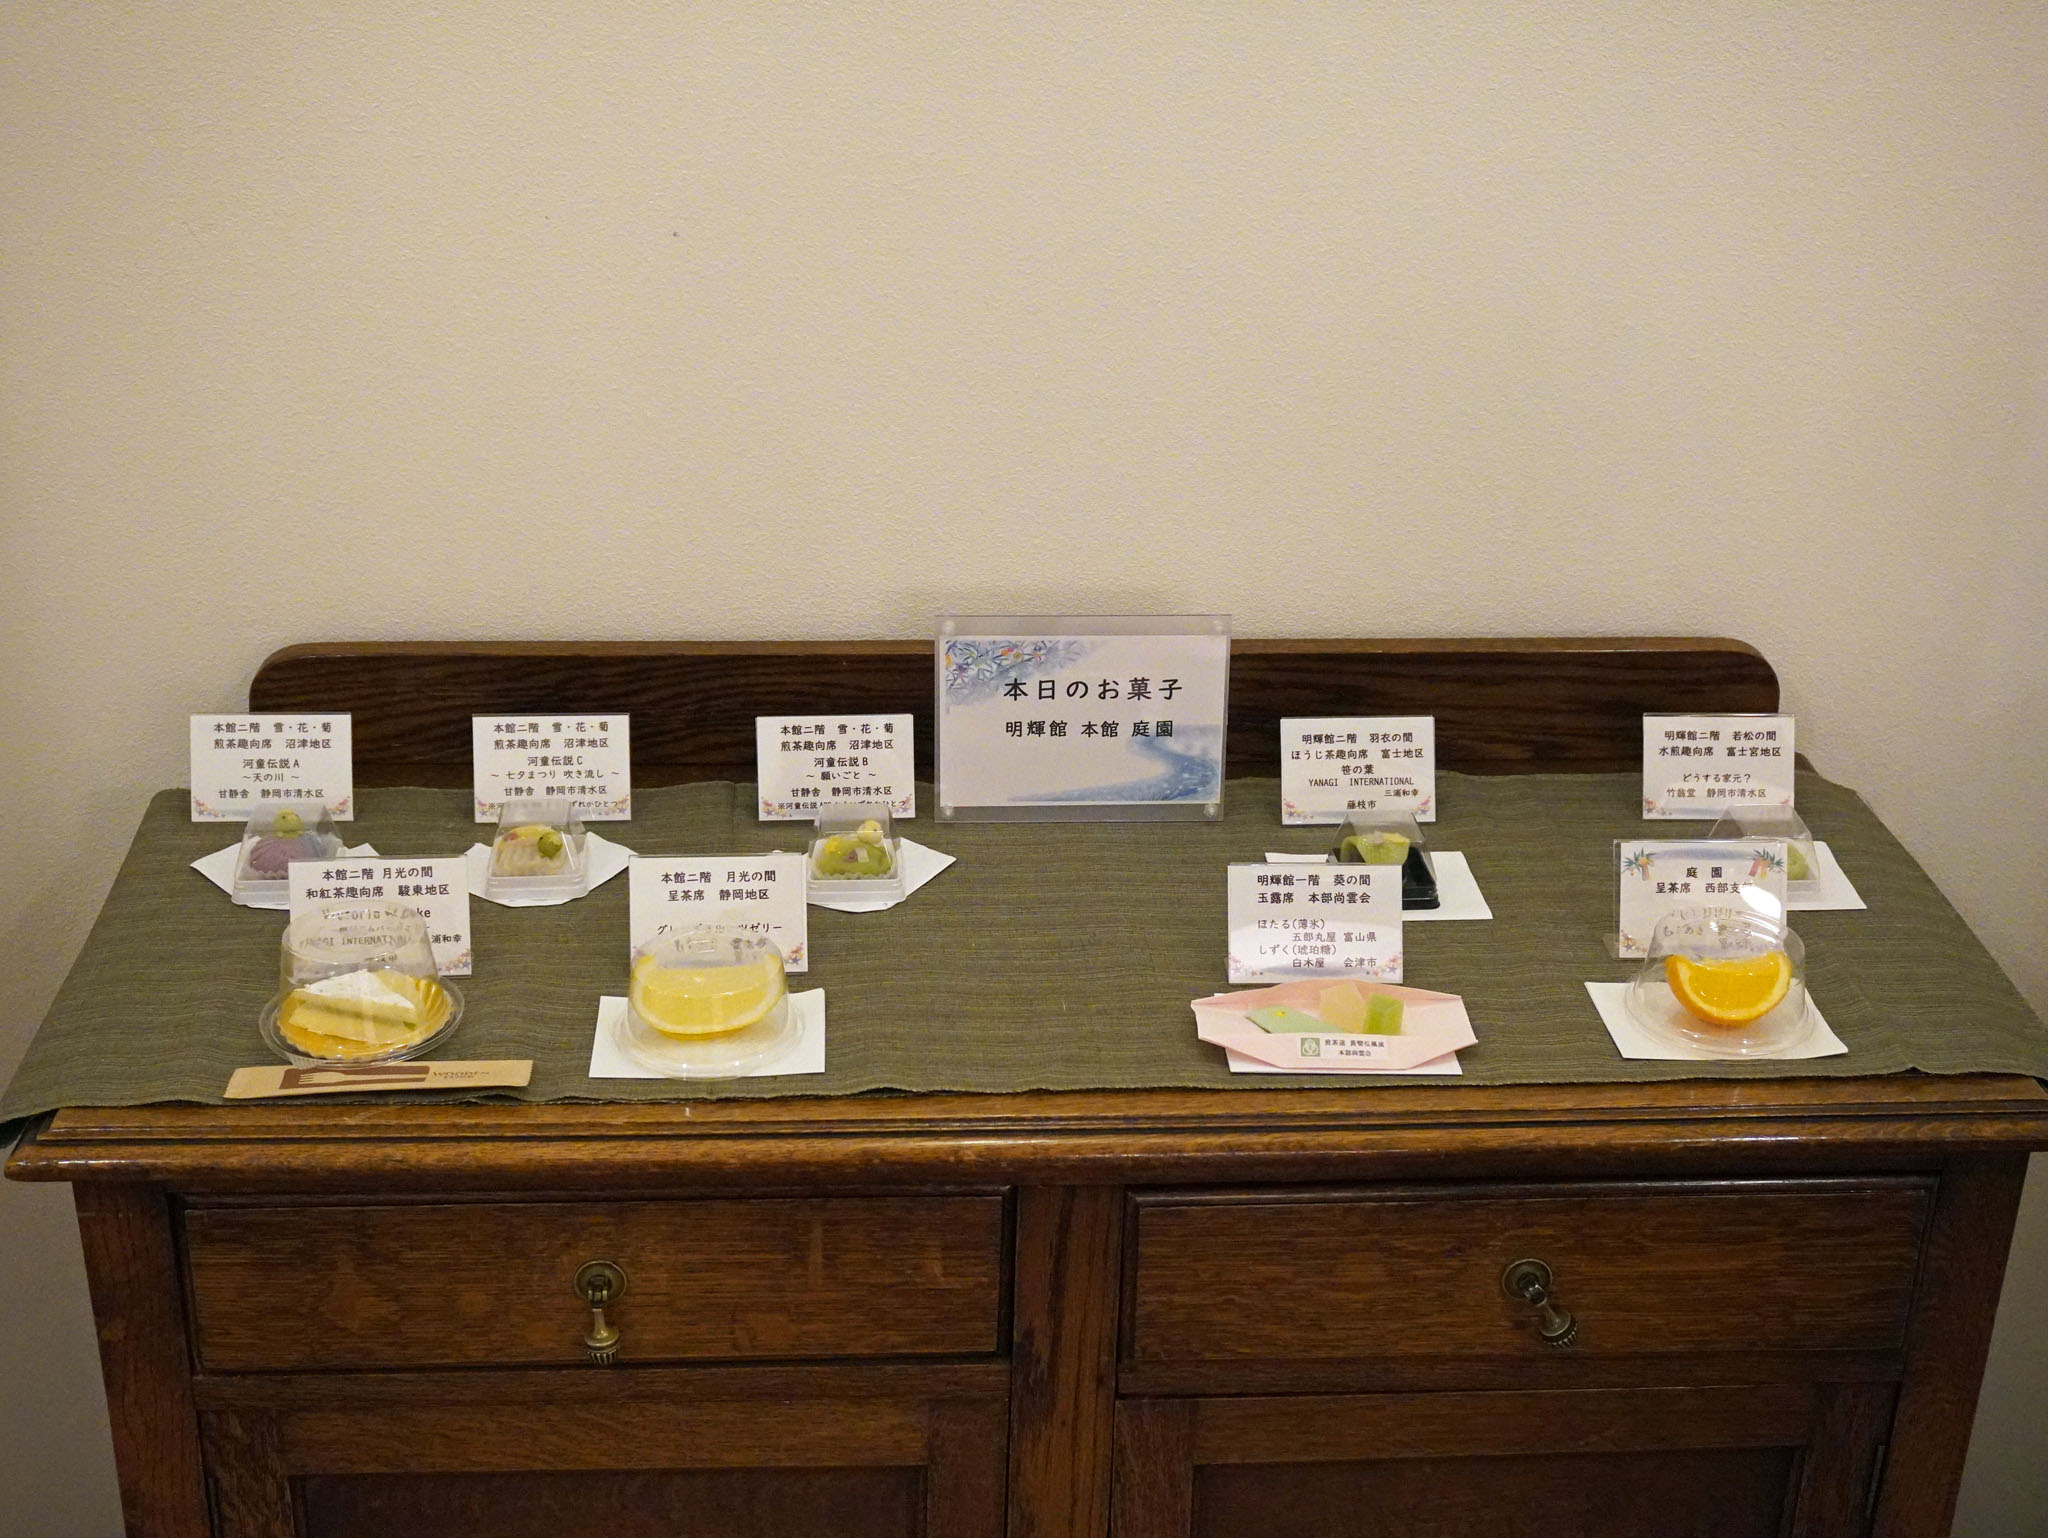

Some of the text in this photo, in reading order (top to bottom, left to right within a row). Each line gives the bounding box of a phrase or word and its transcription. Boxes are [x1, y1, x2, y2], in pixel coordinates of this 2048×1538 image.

[1003, 678, 1183, 701] 本日のお菓子
[214, 722, 260, 733] 本館二階
[494, 723, 539, 733] 本館二階
[781, 725, 825, 735] 本館二階
[1006, 720, 1174, 737] 明輝館 本館 庭園
[1302, 733, 1413, 744] 明輝館二階 羽衣の間
[1665, 731, 1777, 740] 明輝館二階 若松の間
[214, 739, 331, 749] 煎茶趣向席 沼津地区
[494, 738, 608, 750] 煎茶趣向席 沼津地区
[781, 739, 894, 751] 煎茶趣向席 沼津地区
[1291, 749, 1424, 760] ほうじ茶趣向席 富士地区
[1659, 747, 1781, 756] 水煎趣向席 富士宮地区
[1341, 765, 1374, 775] 笹の葉
[1309, 777, 1414, 787] YANAGI INTERNATIONAL
[219, 789, 324, 798] 甘静舎 静岡市清水区
[504, 786, 607, 796] 甘静舎 静岡市清水区
[792, 787, 892, 797] 甘静舎 静岡市清水区
[1384, 789, 1419, 797] 三浦和幸
[1707, 789, 1766, 798] 静岡市清水区
[1347, 801, 1376, 809] 藤枝市
[322, 866, 432, 881] 本館二階 月光の間
[661, 870, 776, 883] 本館二階 月光の間
[1258, 874, 1371, 886] 明輝館一階 葵の間
[306, 884, 450, 899] 和紅茶趣向席 駿東地区
[1656, 882, 1691, 893] 呈茶席
[668, 889, 769, 902] 呈茶席 静岡地区
[1258, 892, 1371, 903] 玉露席 本部尚雲会
[1292, 932, 1377, 942] 五郎丸屋 富山県
[1292, 957, 1377, 968] 白木屋 会津市
